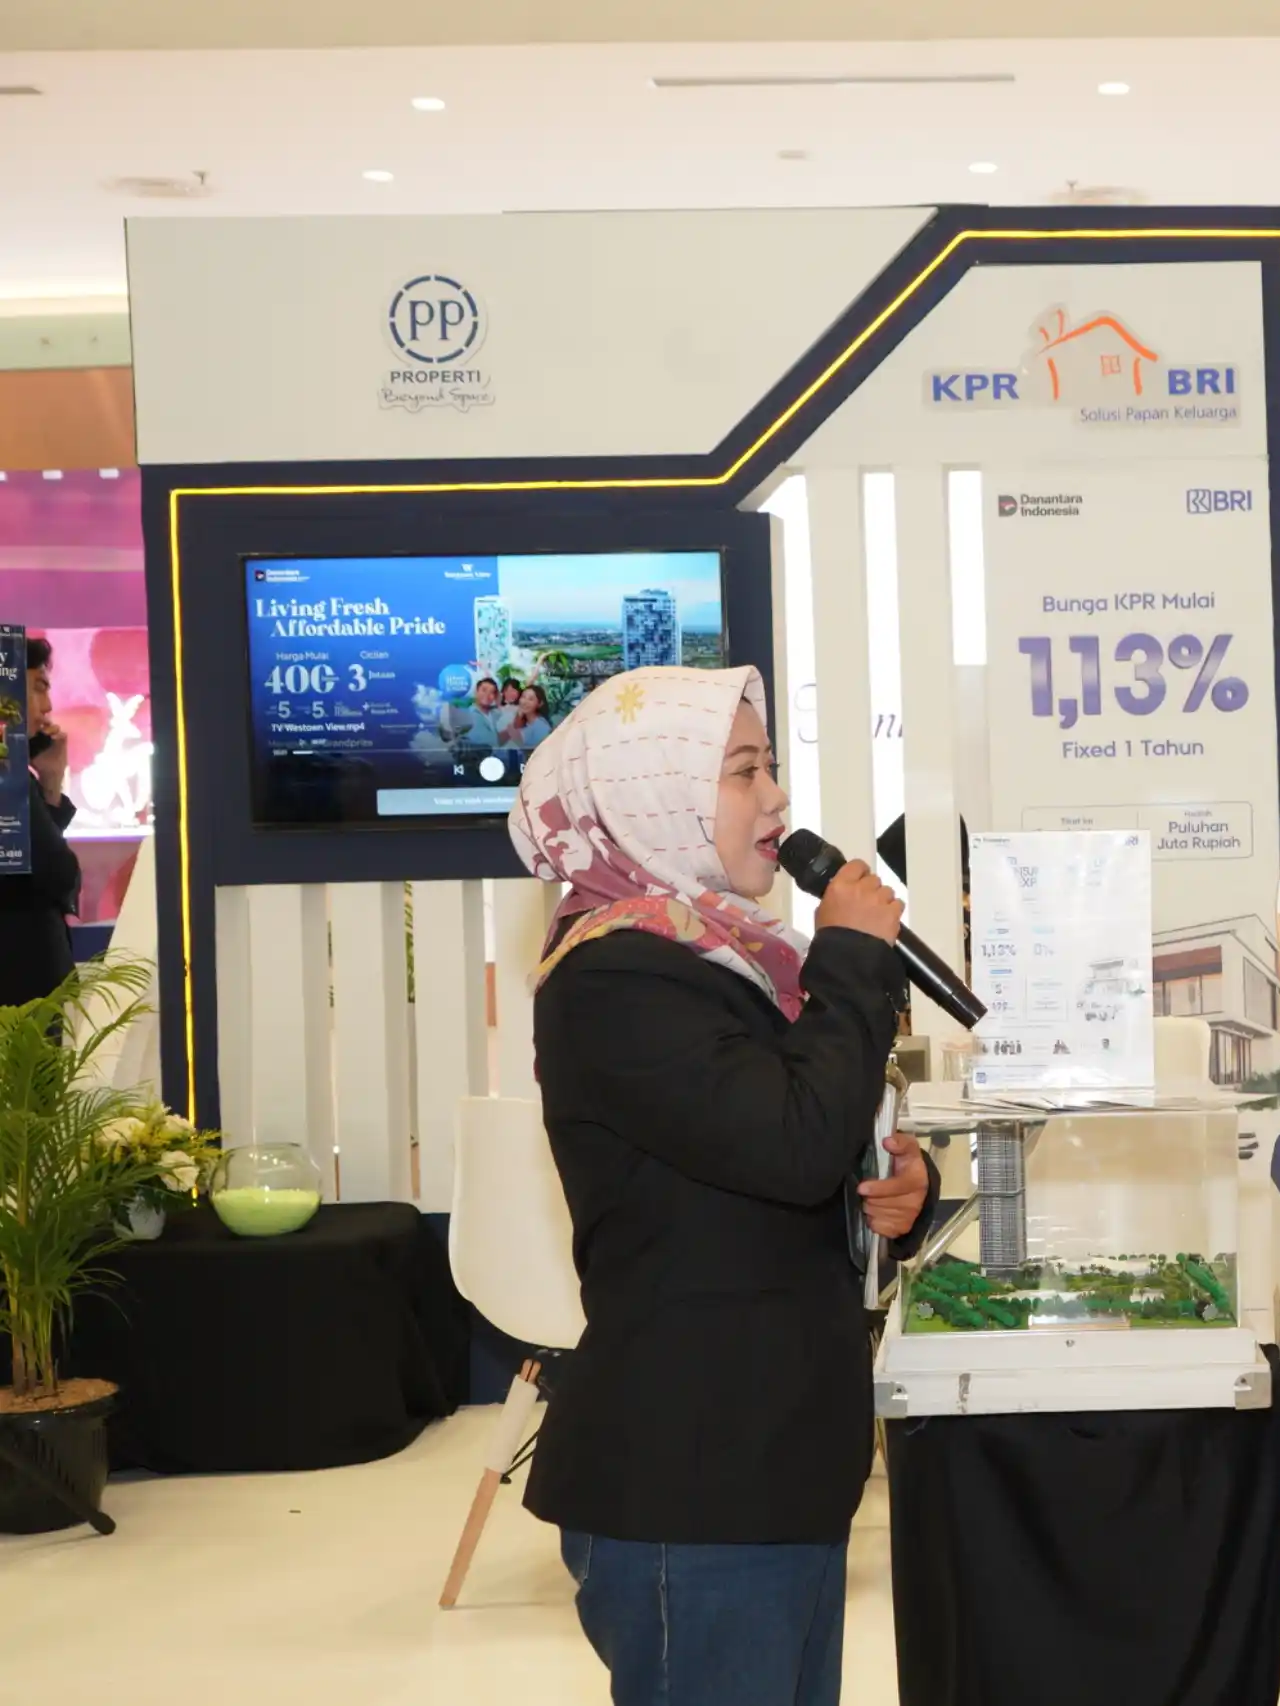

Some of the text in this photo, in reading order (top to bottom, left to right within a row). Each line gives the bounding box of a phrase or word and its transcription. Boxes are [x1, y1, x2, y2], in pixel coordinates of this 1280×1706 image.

[390, 370, 481, 383] PROPERTI
[932, 368, 1236, 402] KPR BRI
[1080, 404, 1237, 424] Solusi Papan Keluarga
[1020, 494, 1083, 505] Danantara
[1213, 489, 1253, 513] BRI
[1020, 505, 1080, 517] Indonesia
[255, 597, 390, 622] Living Fresh
[1042, 591, 1216, 616] Bunga KPR Mulai
[270, 616, 446, 638] Affordable Pride
[348, 663, 367, 692] 3
[1018, 632, 1250, 730] 1,13%
[278, 701, 292, 719] 5
[312, 701, 325, 719] 5
[1062, 739, 1204, 758] Fixed 1 Tahun
[1168, 819, 1229, 834] Puluhan
[1157, 835, 1241, 854] Juta Rupiah
